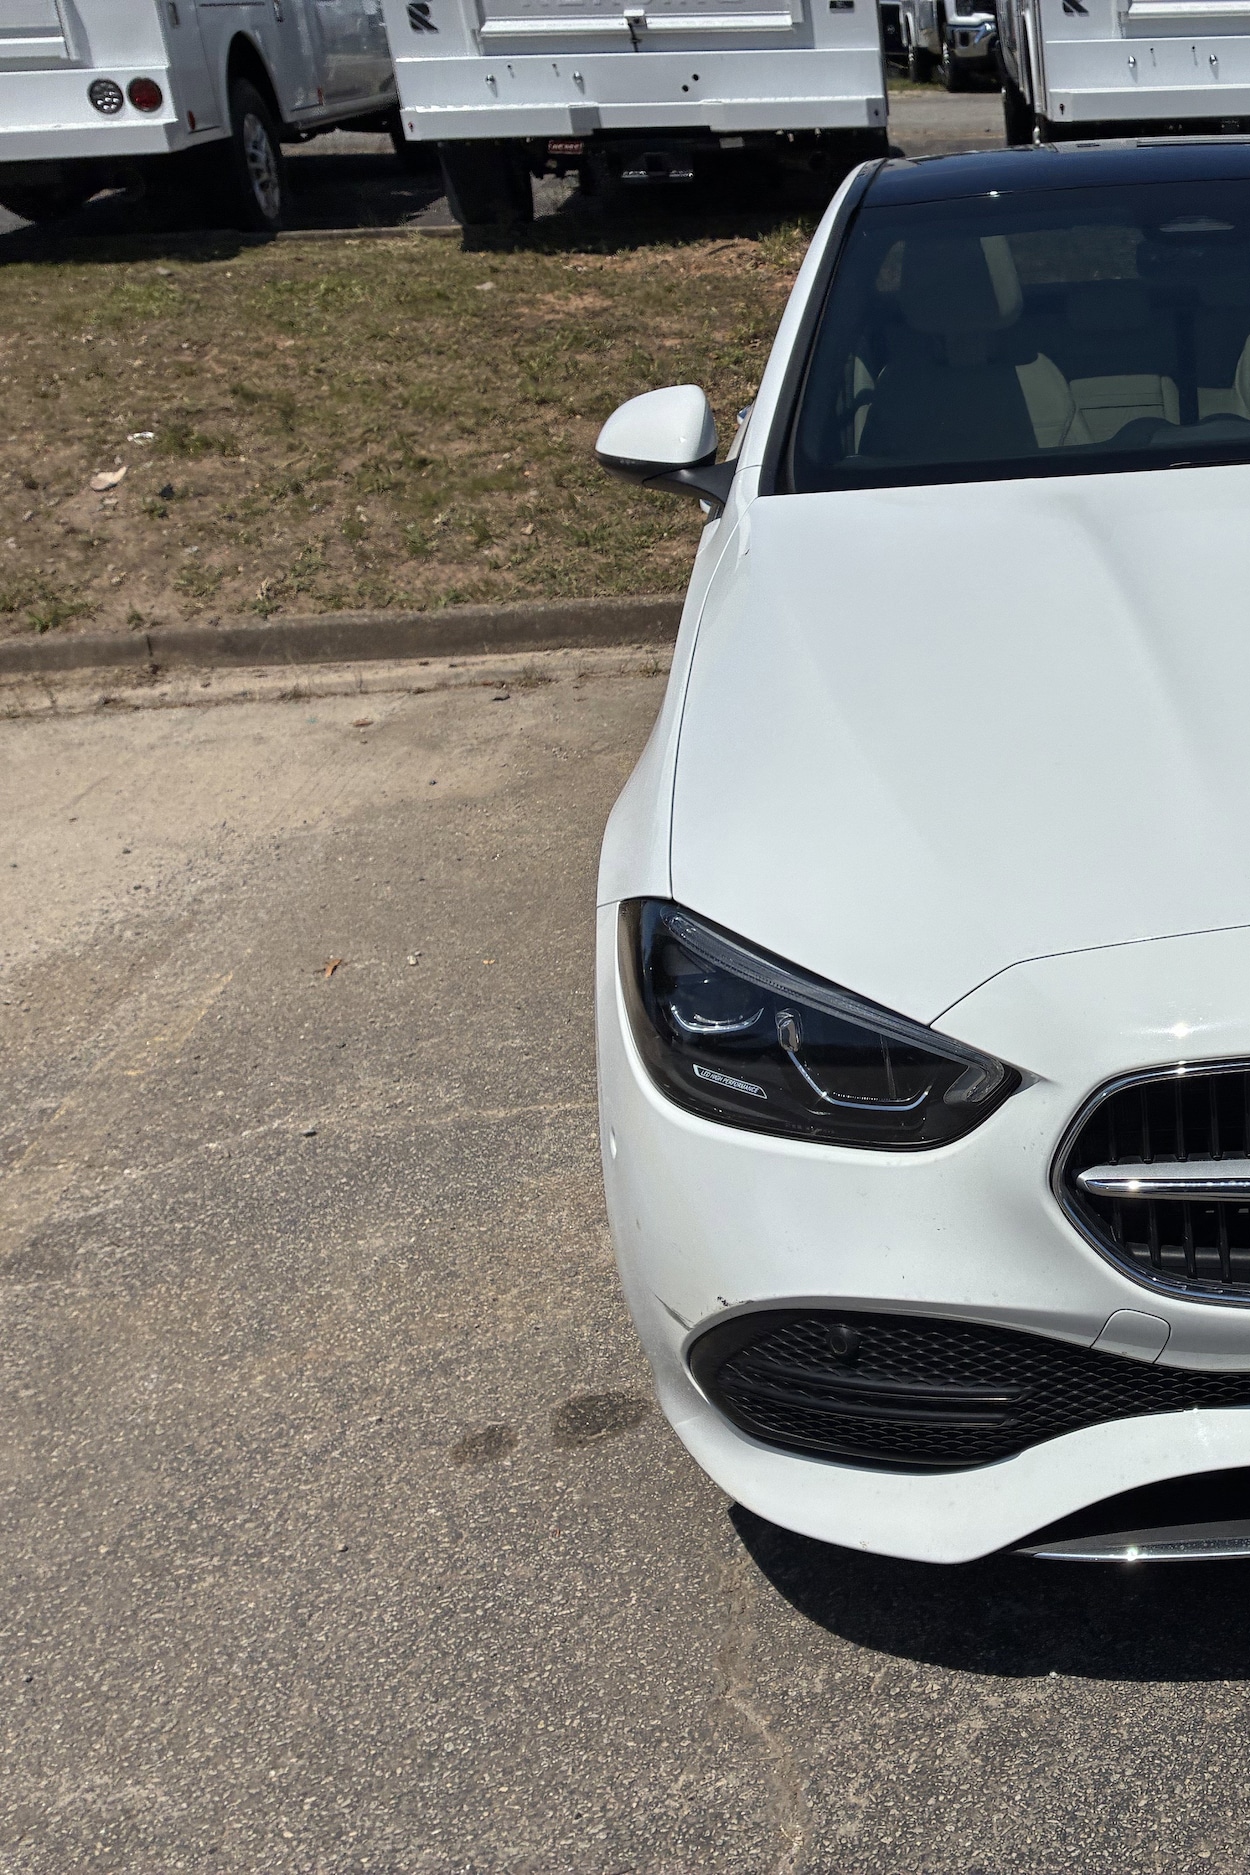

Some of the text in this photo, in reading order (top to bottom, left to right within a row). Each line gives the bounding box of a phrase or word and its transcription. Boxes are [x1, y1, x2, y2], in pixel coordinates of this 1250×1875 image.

[700, 1069, 760, 1094] LED HIGH PERFORMANCE
